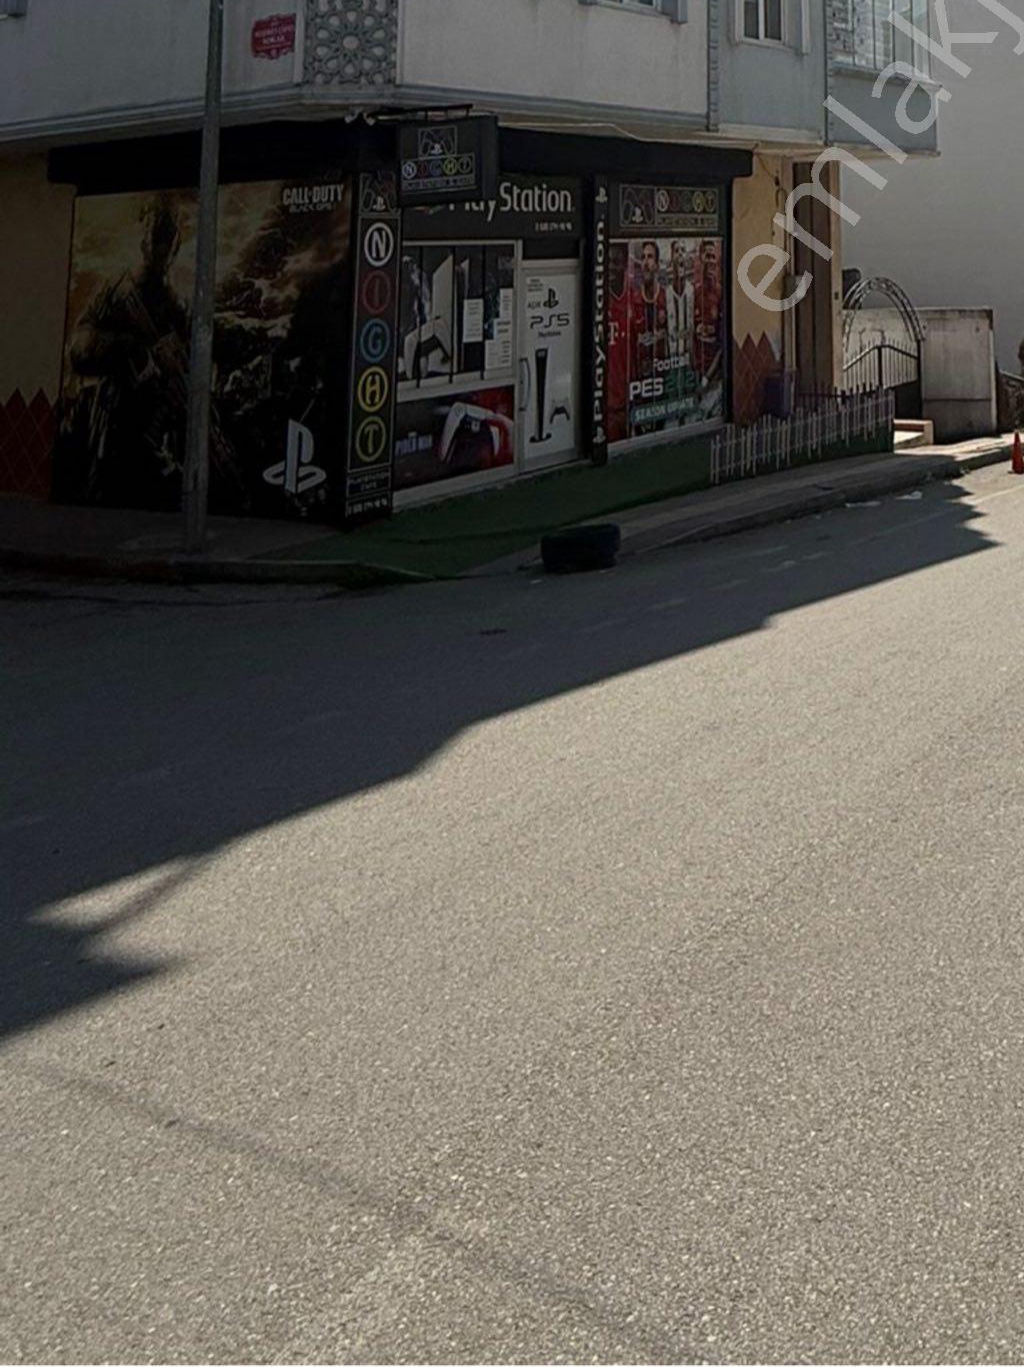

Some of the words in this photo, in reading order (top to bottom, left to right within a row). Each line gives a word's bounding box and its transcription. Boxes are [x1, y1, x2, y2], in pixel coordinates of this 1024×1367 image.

[283, 185, 310, 206] CALL
[312, 183, 344, 203] DUTY
[530, 313, 570, 329] PS5
[629, 376, 665, 401] PES
